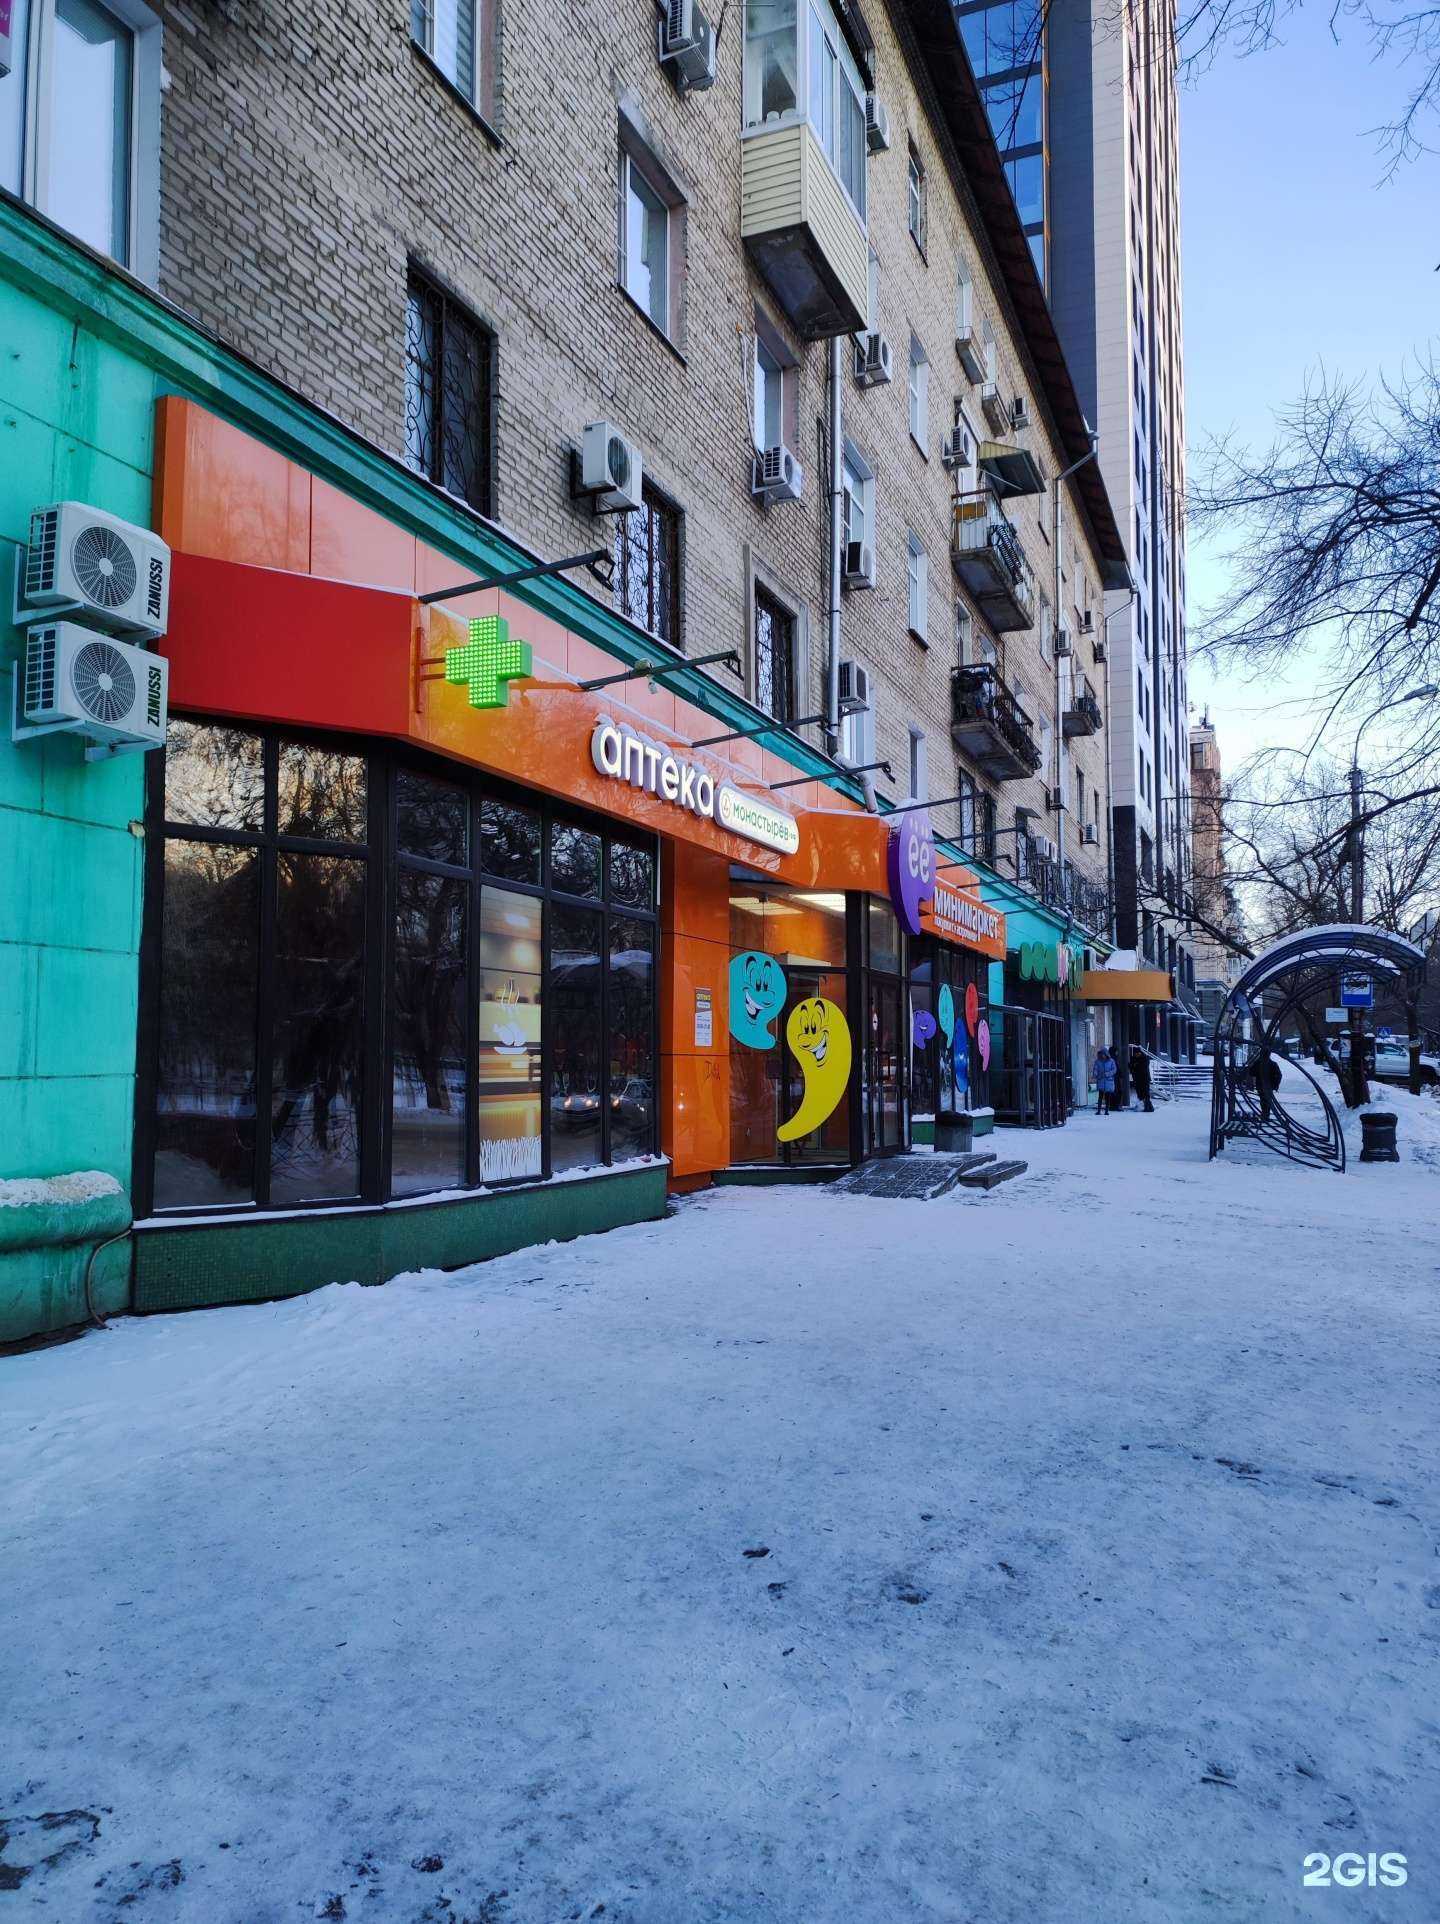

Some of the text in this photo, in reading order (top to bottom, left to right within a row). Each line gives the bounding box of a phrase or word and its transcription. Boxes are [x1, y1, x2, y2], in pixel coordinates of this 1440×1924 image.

[147, 557, 164, 620] ZANUSSI
[147, 665, 162, 728] ZANUSSI
[599, 725, 714, 818] аптека
